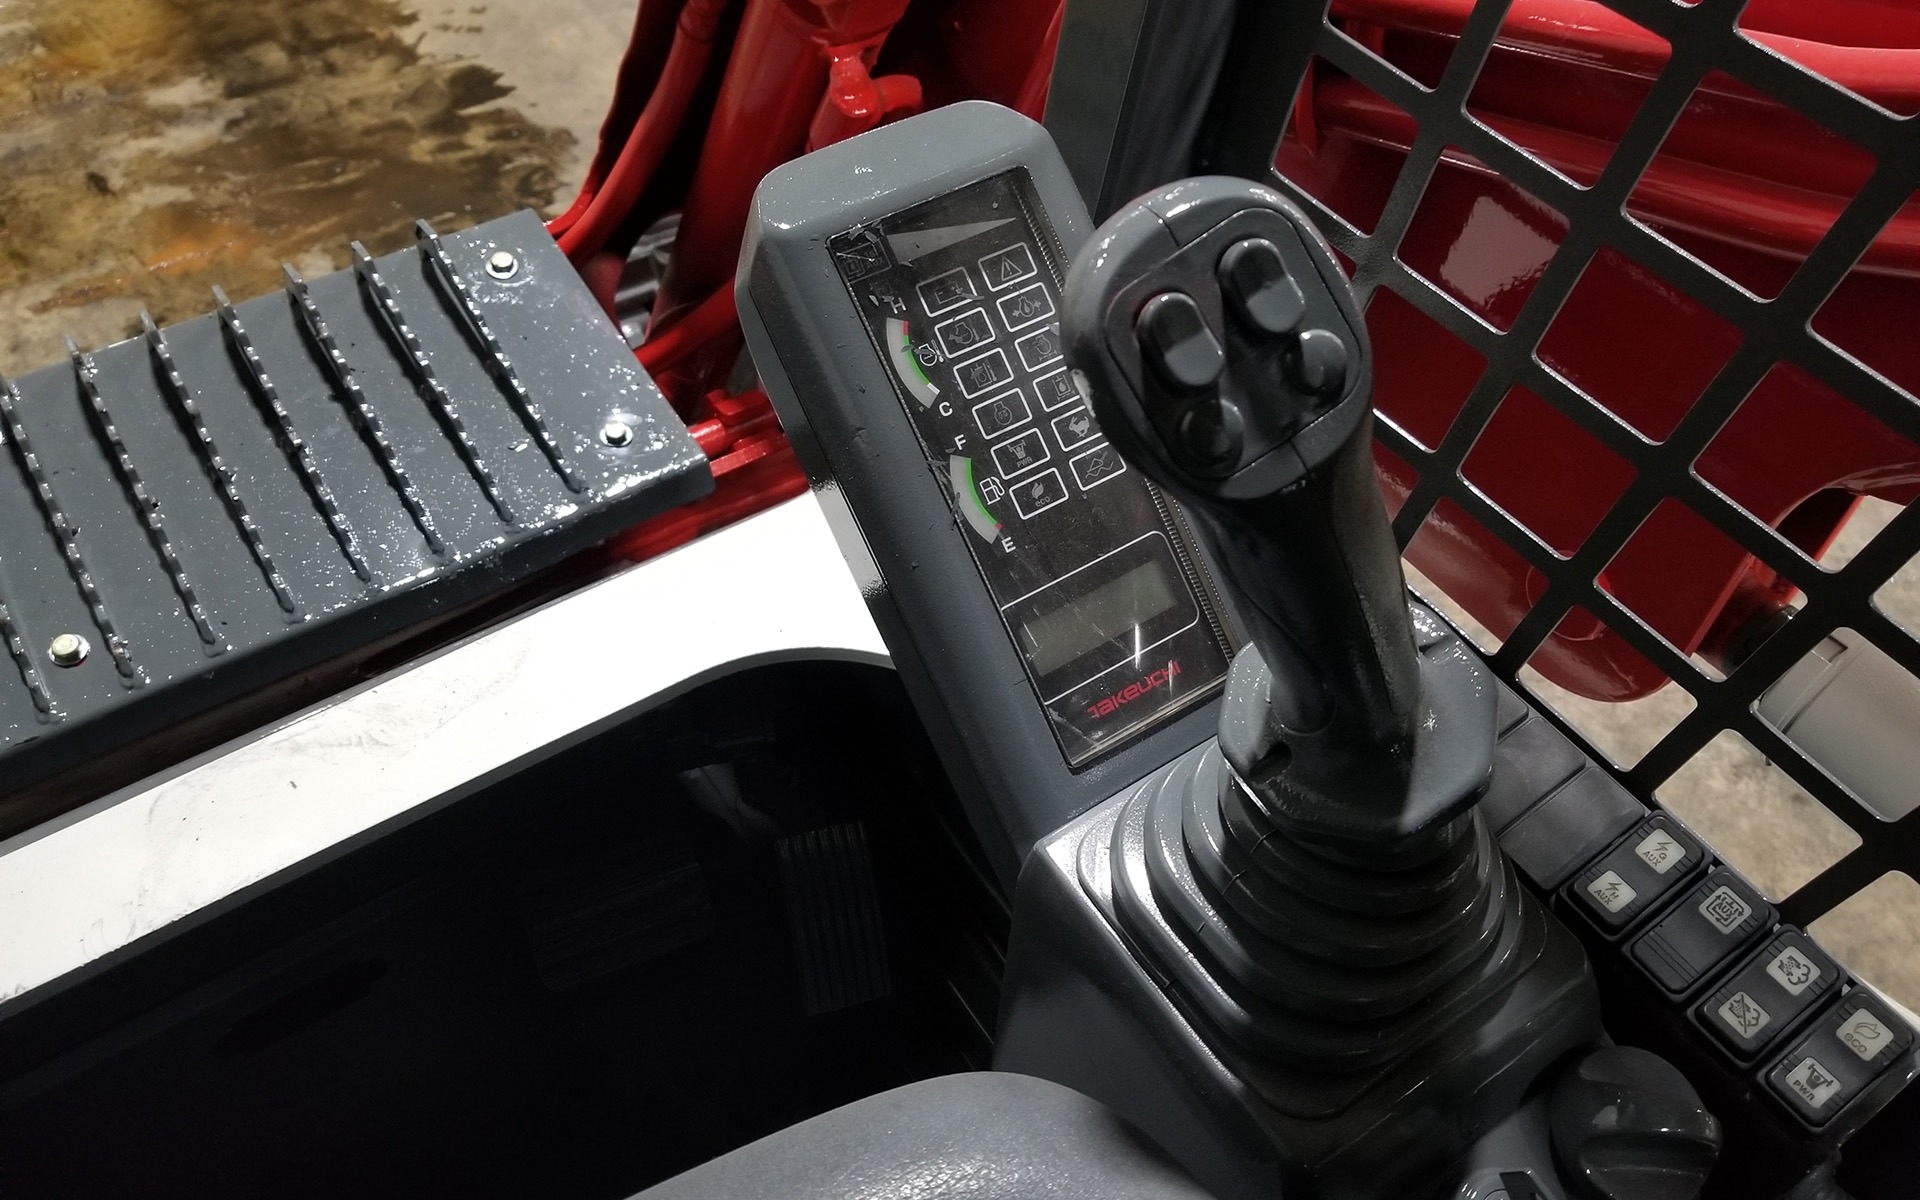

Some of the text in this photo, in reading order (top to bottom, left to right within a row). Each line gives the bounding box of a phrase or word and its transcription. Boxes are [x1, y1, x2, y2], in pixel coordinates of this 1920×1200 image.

[890, 296, 907, 314] H
[939, 402, 953, 417] C
[954, 434, 967, 450] F
[1016, 457, 1033, 468] PWR
[1001, 536, 1016, 553] E
[1642, 850, 1662, 867] AUX
[1593, 889, 1613, 905] AUX
[1716, 901, 1735, 919] AUX
[1793, 1079, 1816, 1101] PWR
